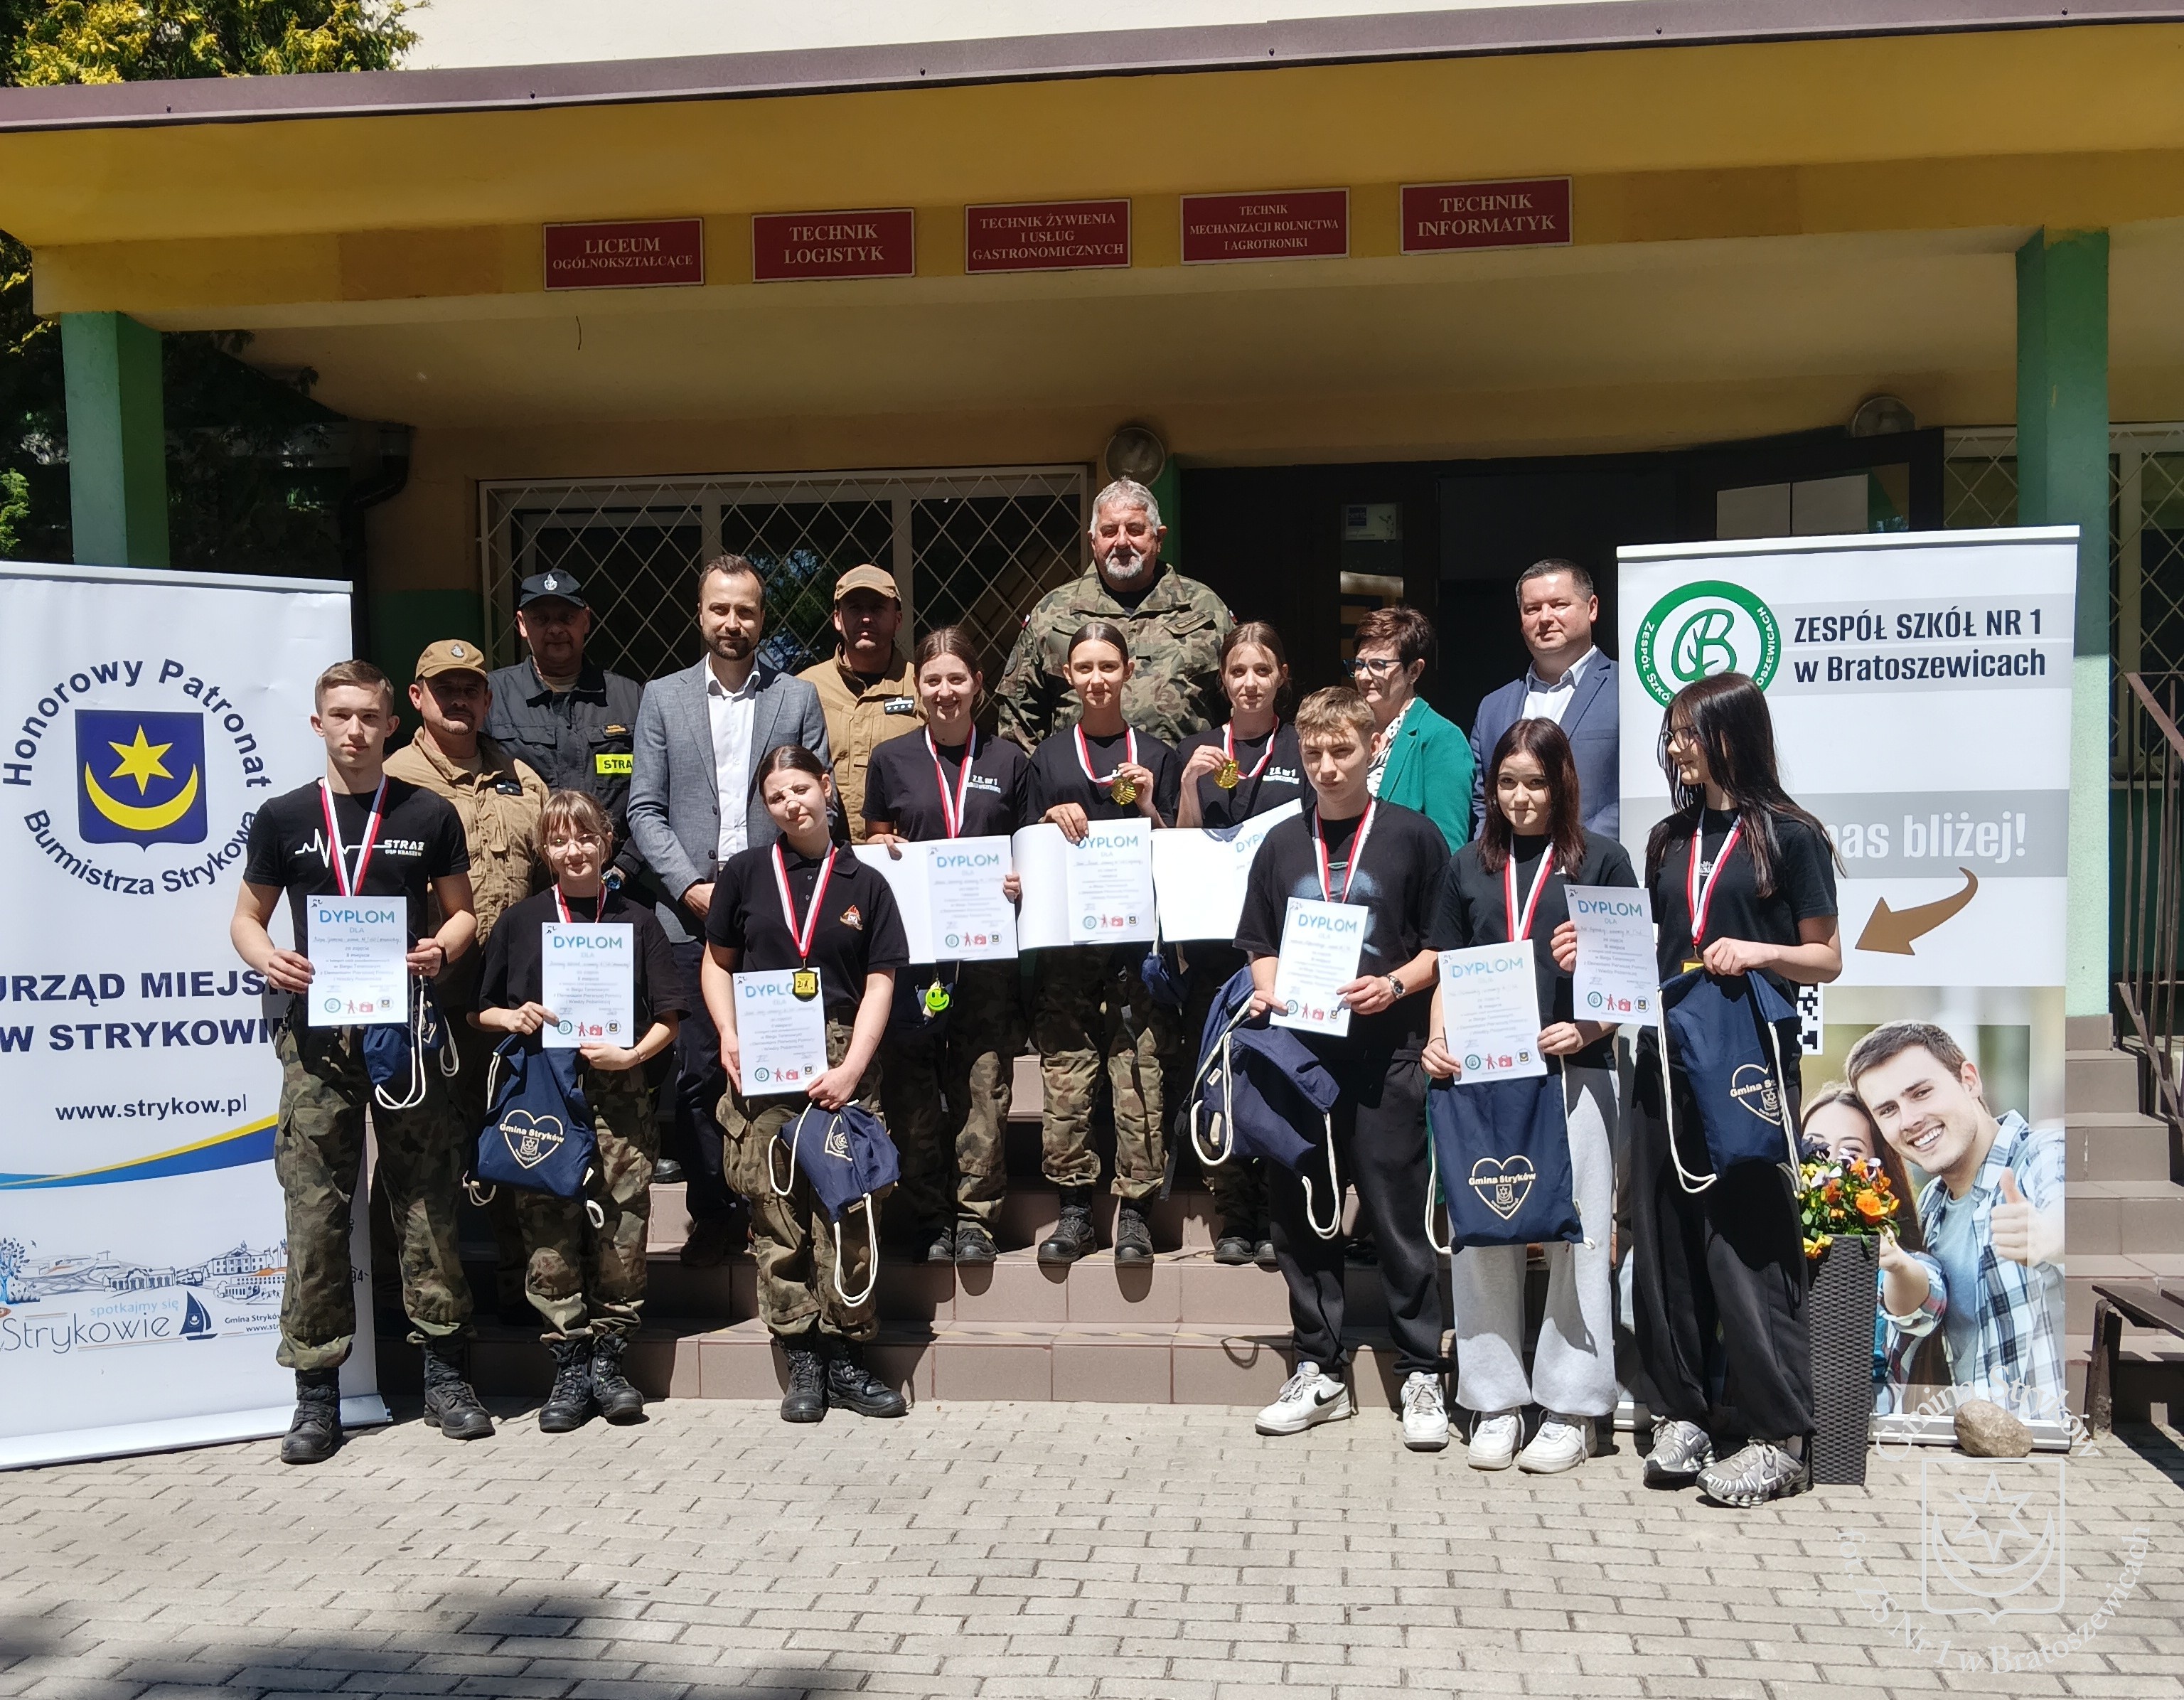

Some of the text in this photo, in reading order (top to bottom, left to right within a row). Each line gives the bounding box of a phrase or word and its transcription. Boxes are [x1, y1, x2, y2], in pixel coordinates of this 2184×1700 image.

[1239, 205, 1288, 216] TECHNIK
[1440, 193, 1533, 213] TECHNIK
[980, 212, 1115, 229] TECHNIK ŻYWIENIA
[1189, 219, 1339, 235] MECHANIZACJI ROLNICTWA
[1417, 215, 1556, 237] INFORMATYK
[789, 223, 878, 242] TECHNIK
[1020, 230, 1075, 242] I USŁUG
[584, 237, 661, 255] LICEUM
[973, 243, 1123, 261] GASTRONOMICZNYCH
[1224, 237, 1308, 250] I AGROTRONIKI
[552, 254, 694, 270] OGÓLNOKSZTAŁCĄCE
[783, 245, 885, 264] LOGISTYK
[1794, 605, 2041, 643] ZESPÓŁ SZKÓŁ NR 1
[1755, 606, 1776, 687] OSZEWICACH
[1794, 648, 2045, 683] w Bratoszewicach
[1647, 673, 1671, 703] SZKÓ
[3, 658, 272, 788] Honorowy Patronat
[604, 759, 633, 769] STRA
[1904, 811, 2026, 864] bliżej!
[24, 809, 257, 895] Burmistrza Strykowa
[937, 854, 1000, 868] DYPLOM
[320, 909, 395, 924] DYPLOM
[1578, 899, 1643, 917] DYPLOM
[1298, 914, 1357, 933] DYPLOM
[554, 936, 622, 948] DYPLOM
[1452, 957, 1524, 978] DYPLOM
[141, 970, 293, 998] MIEJS
[0, 1025, 34, 1052] W
[1730, 1082, 1762, 1098] Gmina
[55, 1094, 247, 1121] www.strykow.pl
[499, 1123, 564, 1143] Gmina Stryków
[1468, 1172, 1536, 1186] Gmina Stryków
[90, 1298, 179, 1317] spotkajmy się
[225, 1315, 250, 1324] Gmina
[245, 1323, 280, 1332] www.str
[2, 1313, 171, 1354] Strykowie
